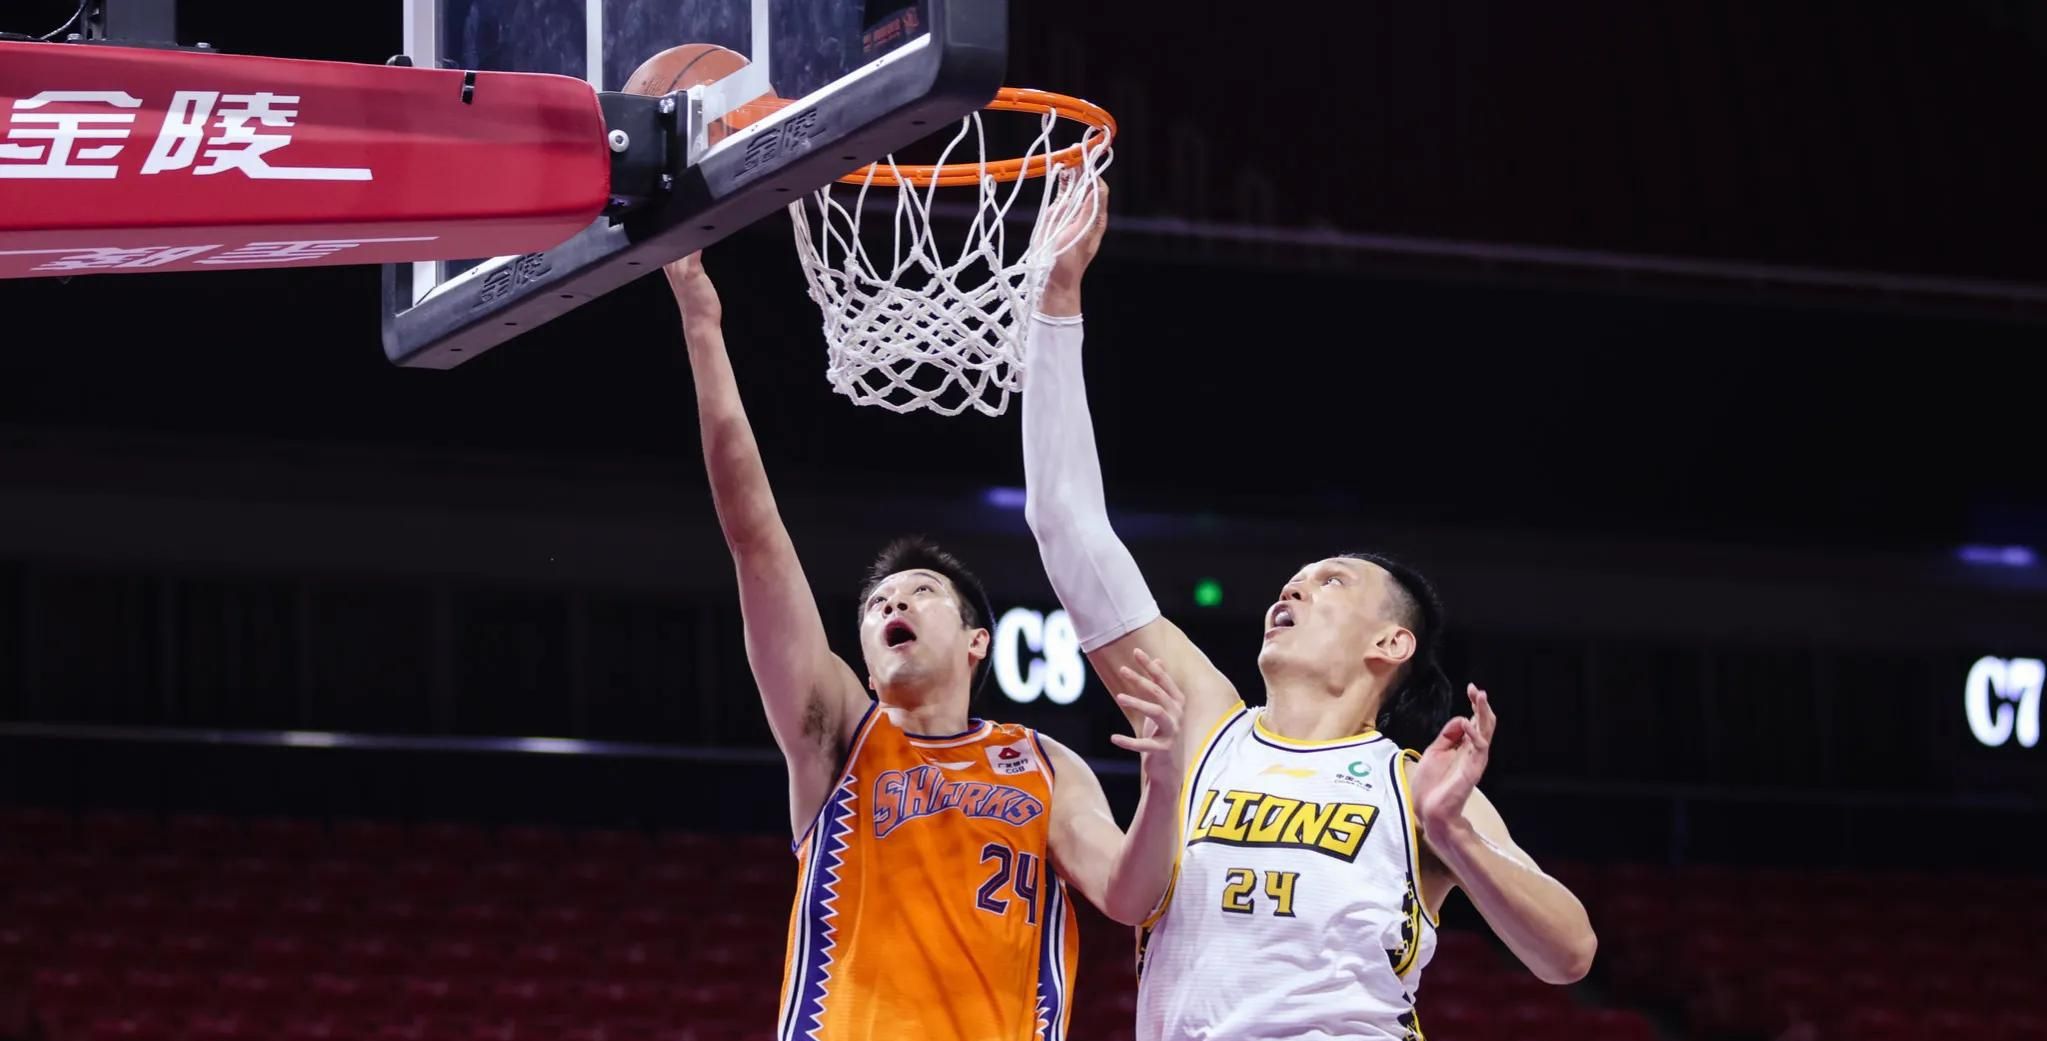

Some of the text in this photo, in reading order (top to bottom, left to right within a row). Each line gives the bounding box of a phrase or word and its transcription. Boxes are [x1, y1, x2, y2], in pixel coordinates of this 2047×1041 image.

[0, 91, 373, 180] 金陵
[994, 607, 1085, 704] C8
[1965, 656, 2045, 747] C7
[873, 764, 1043, 839] SHARKS
[1187, 789, 1380, 864] LIONS
[976, 841, 1039, 926] 24
[1221, 867, 1300, 918] 24
